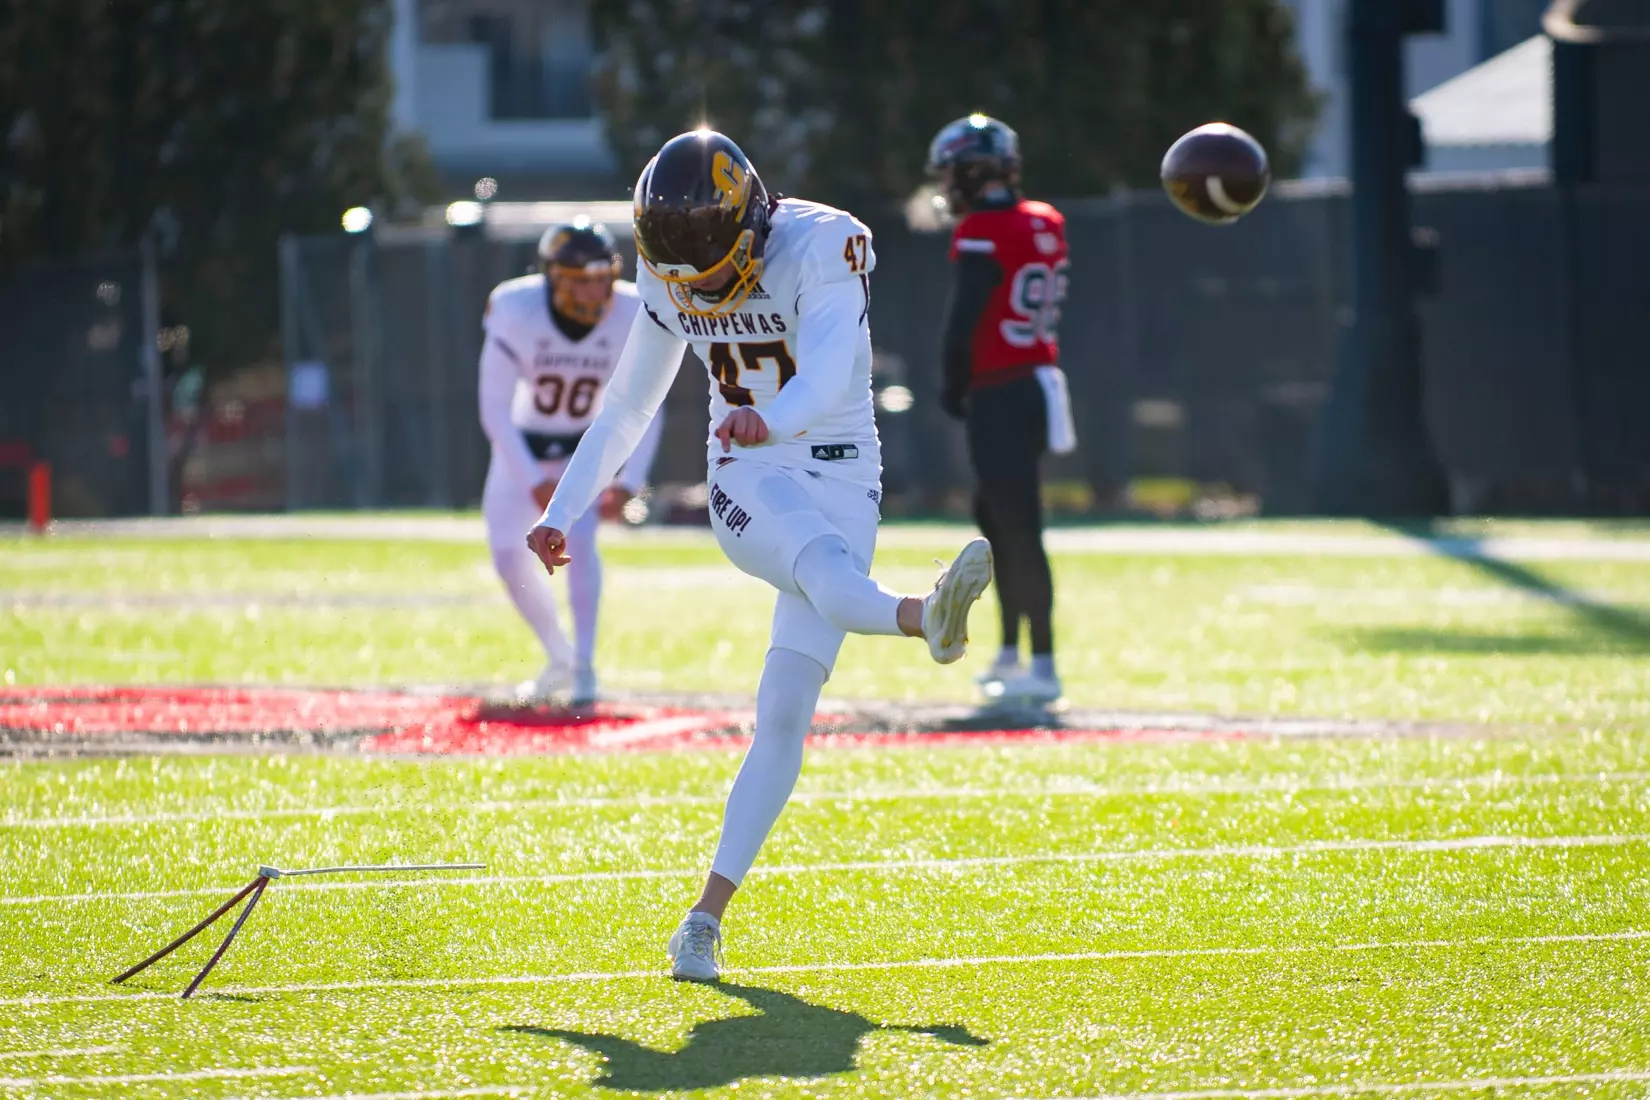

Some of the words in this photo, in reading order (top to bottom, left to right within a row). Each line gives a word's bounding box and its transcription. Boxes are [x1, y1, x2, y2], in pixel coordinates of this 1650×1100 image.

[844, 234, 866, 272] 47
[678, 311, 787, 336] CHIPPEWAS
[709, 339, 796, 406] 47
[710, 482, 733, 520] FIRE
[726, 505, 752, 537] UP!
